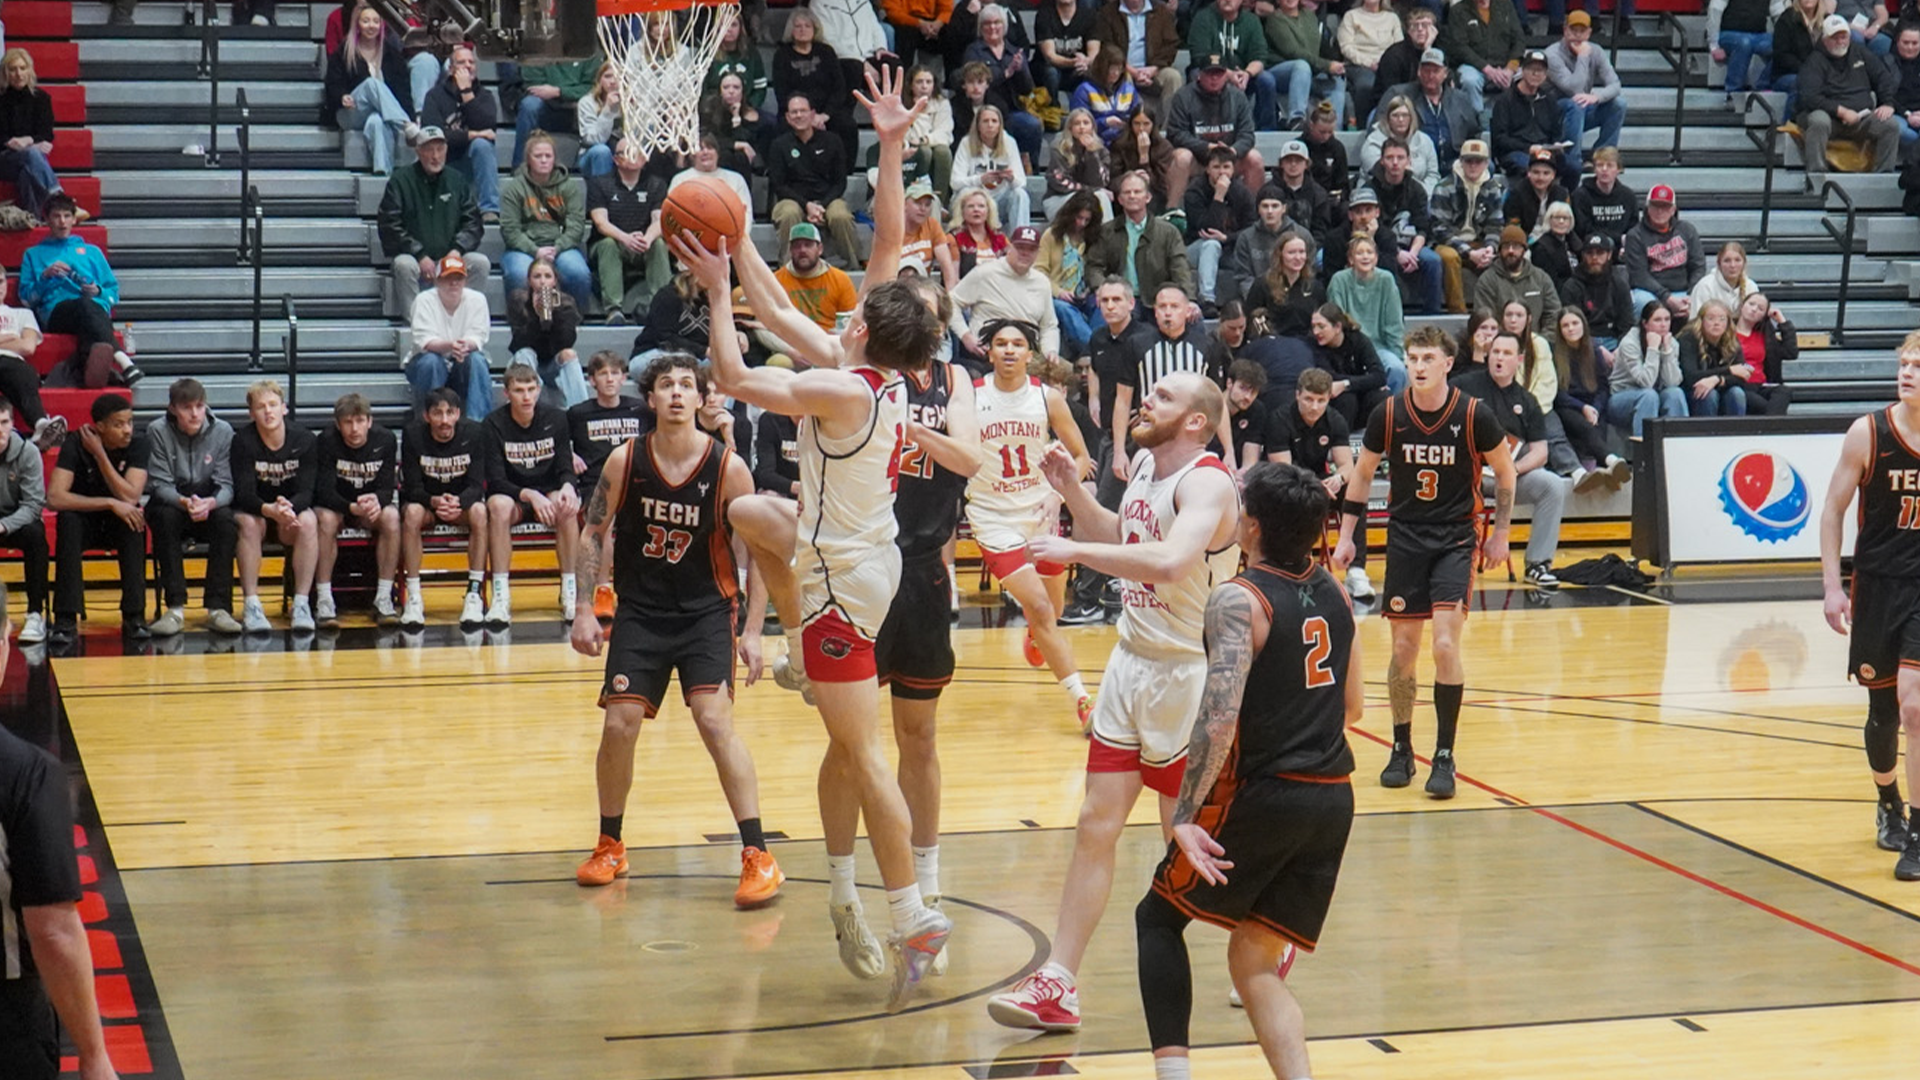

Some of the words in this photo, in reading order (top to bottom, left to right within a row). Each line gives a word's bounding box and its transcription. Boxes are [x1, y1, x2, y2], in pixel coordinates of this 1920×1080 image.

[622, 418, 639, 428] TECH
[908, 404, 948, 430] ECH
[980, 421, 1040, 443] MONTANA
[999, 444, 1030, 479] 11
[1402, 444, 1456, 465] TECH
[1415, 469, 1439, 500] 3
[1888, 469, 1920, 491] TE
[641, 497, 700, 527] TECH
[642, 524, 693, 564] 33
[1302, 616, 1336, 689] 2
